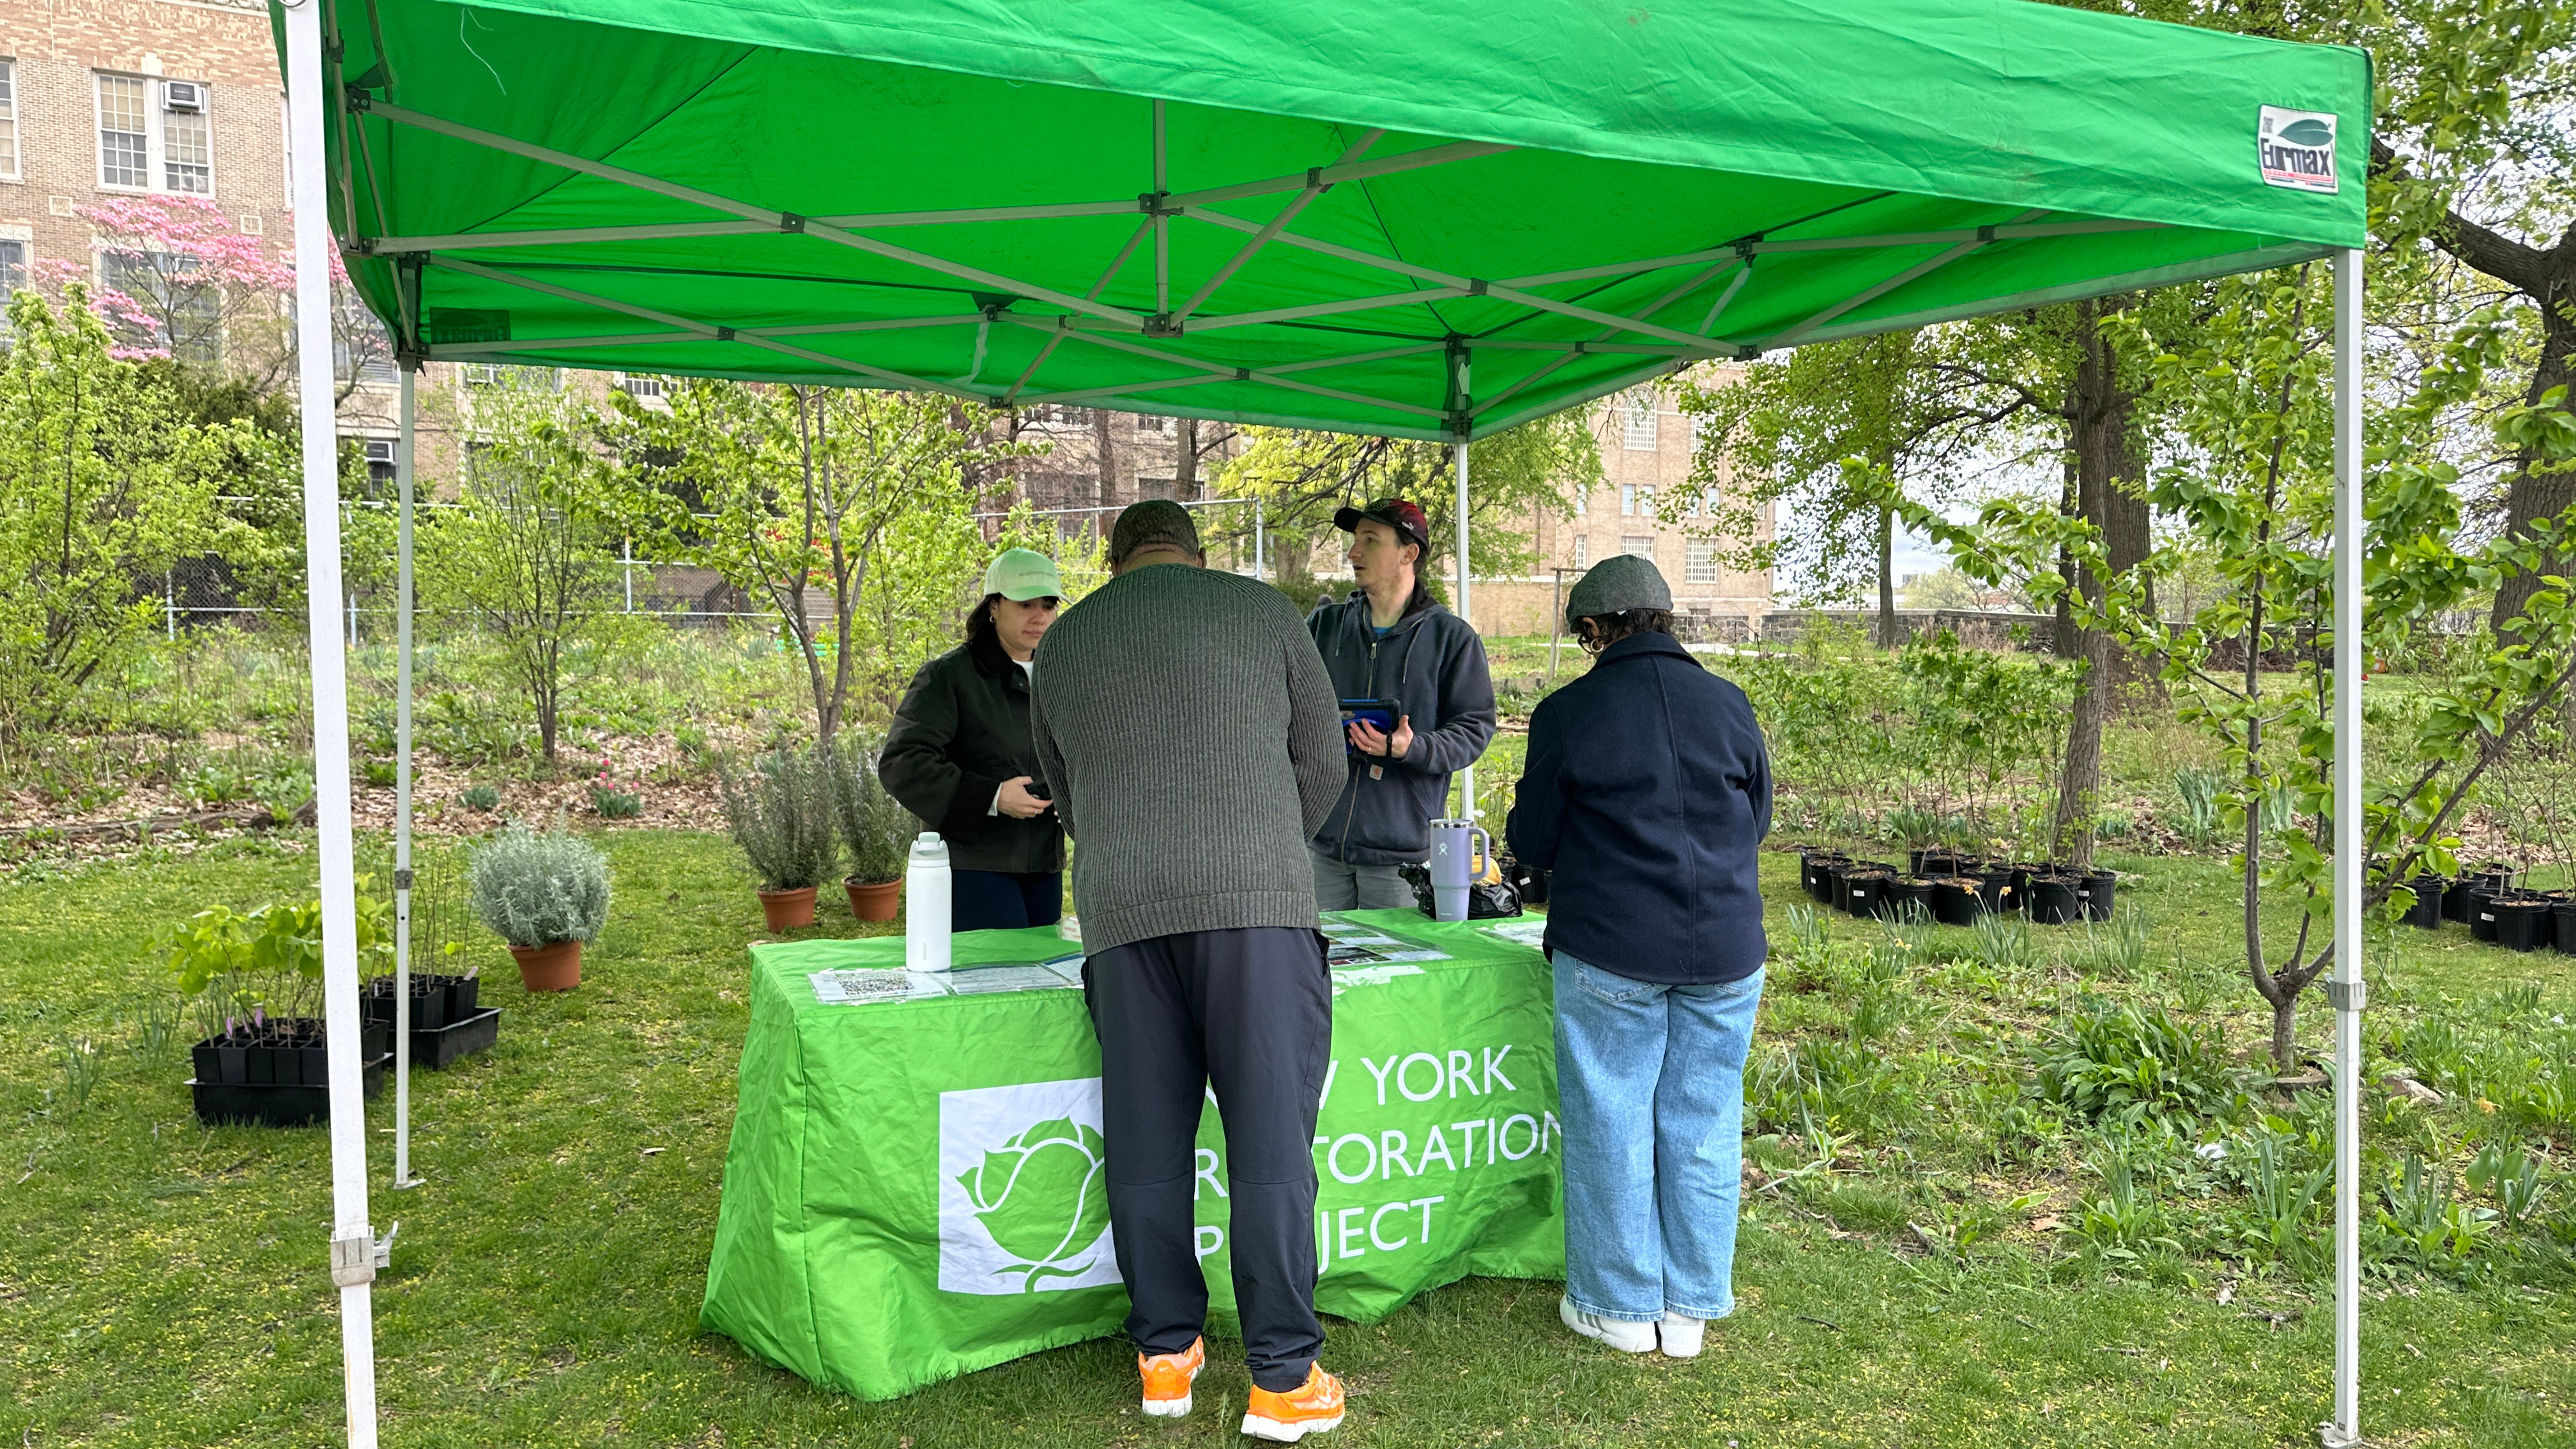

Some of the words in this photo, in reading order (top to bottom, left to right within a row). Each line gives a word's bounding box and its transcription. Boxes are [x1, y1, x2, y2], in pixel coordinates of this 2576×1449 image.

[2260, 137, 2331, 176] Eurmax
[1360, 1044, 1517, 1105] YORK
[1193, 1195, 1445, 1275] PJECT
